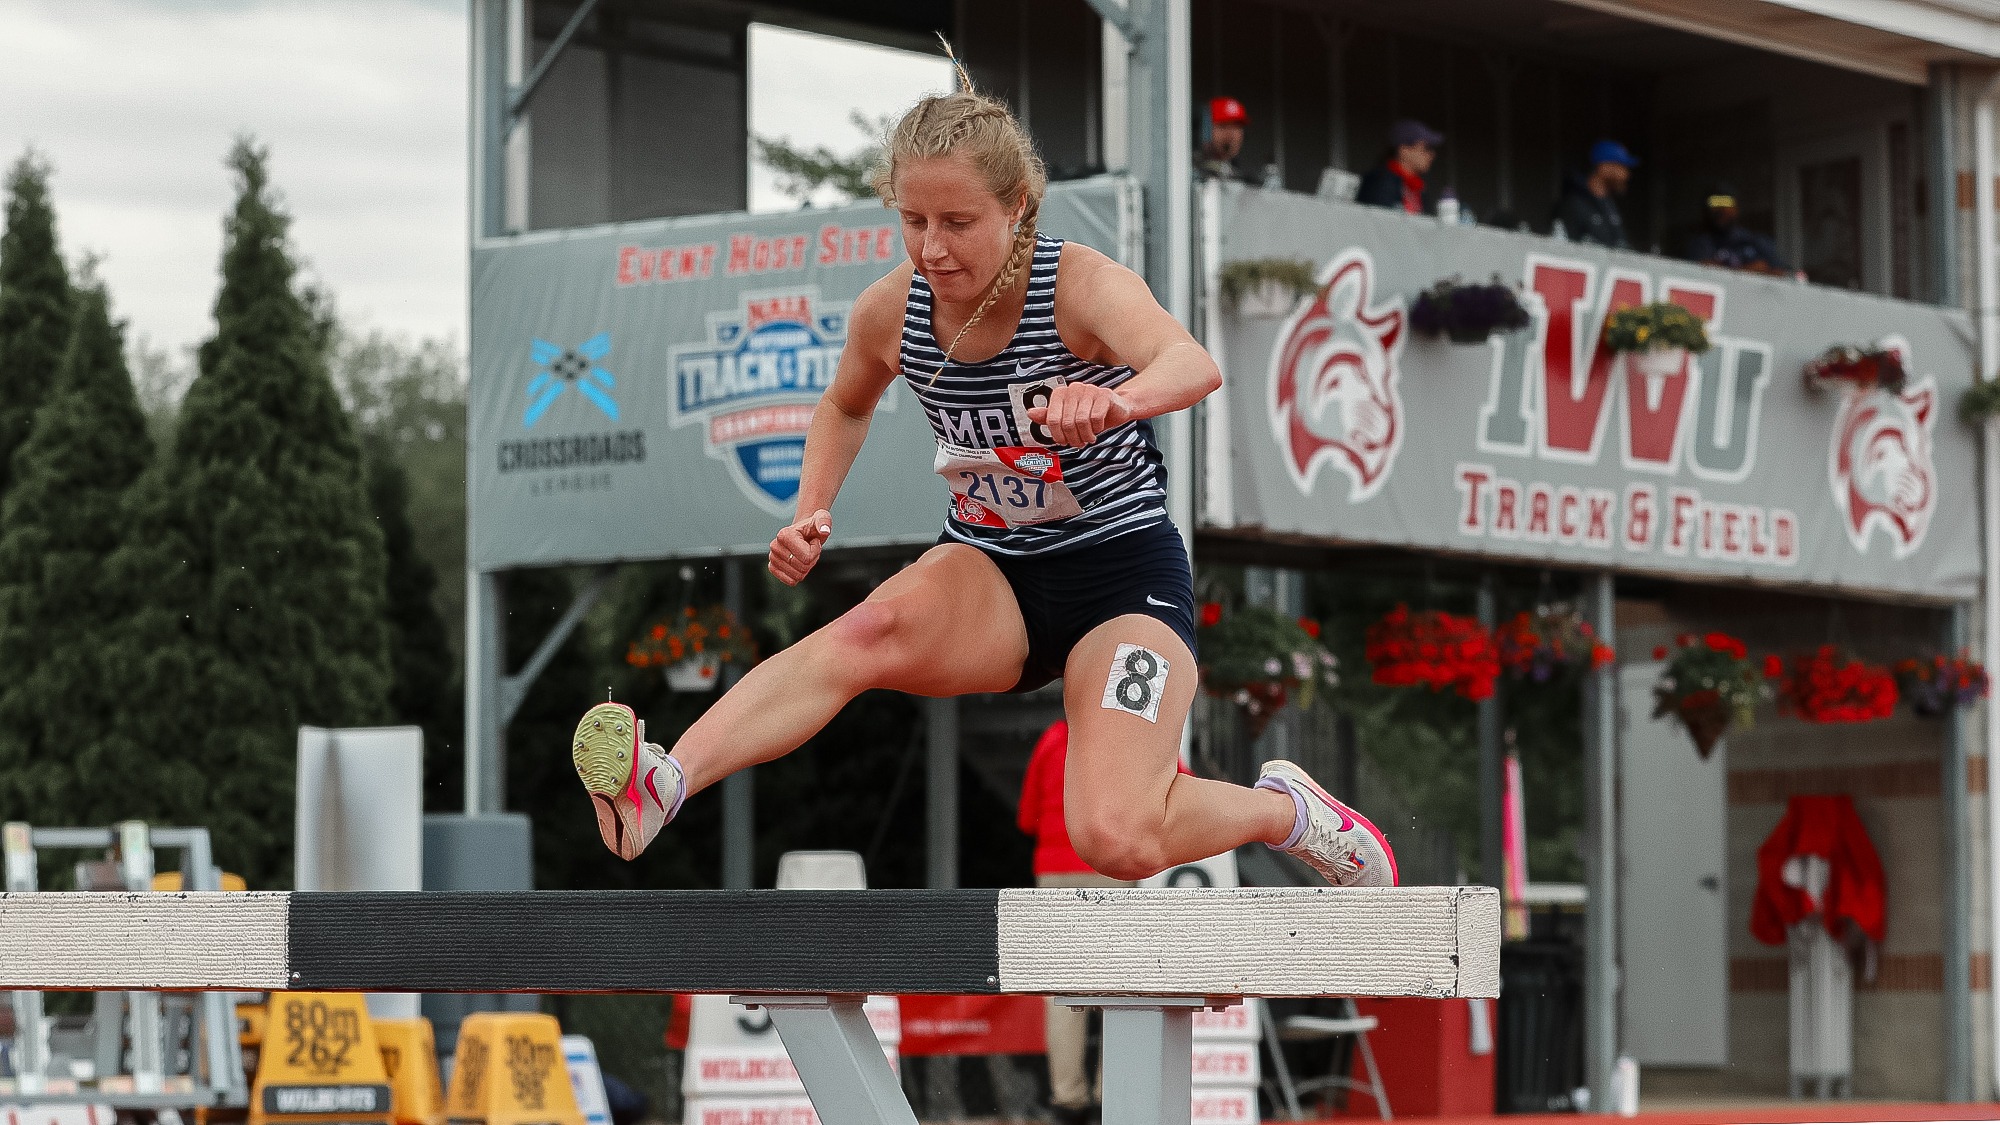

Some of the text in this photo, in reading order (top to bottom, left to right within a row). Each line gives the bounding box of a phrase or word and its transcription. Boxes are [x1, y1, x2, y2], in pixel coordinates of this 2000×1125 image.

[818, 224, 894, 265] SITE
[680, 352, 779, 408] TRACK
[1480, 258, 1766, 478] IWU
[498, 430, 645, 475] CROSSROADS
[959, 471, 1046, 510] 2137
[1461, 471, 1792, 558] TRACK & FIELD
[1116, 649, 1158, 712] 8
[286, 1000, 361, 1043] 80m
[287, 1035, 352, 1068] 262
